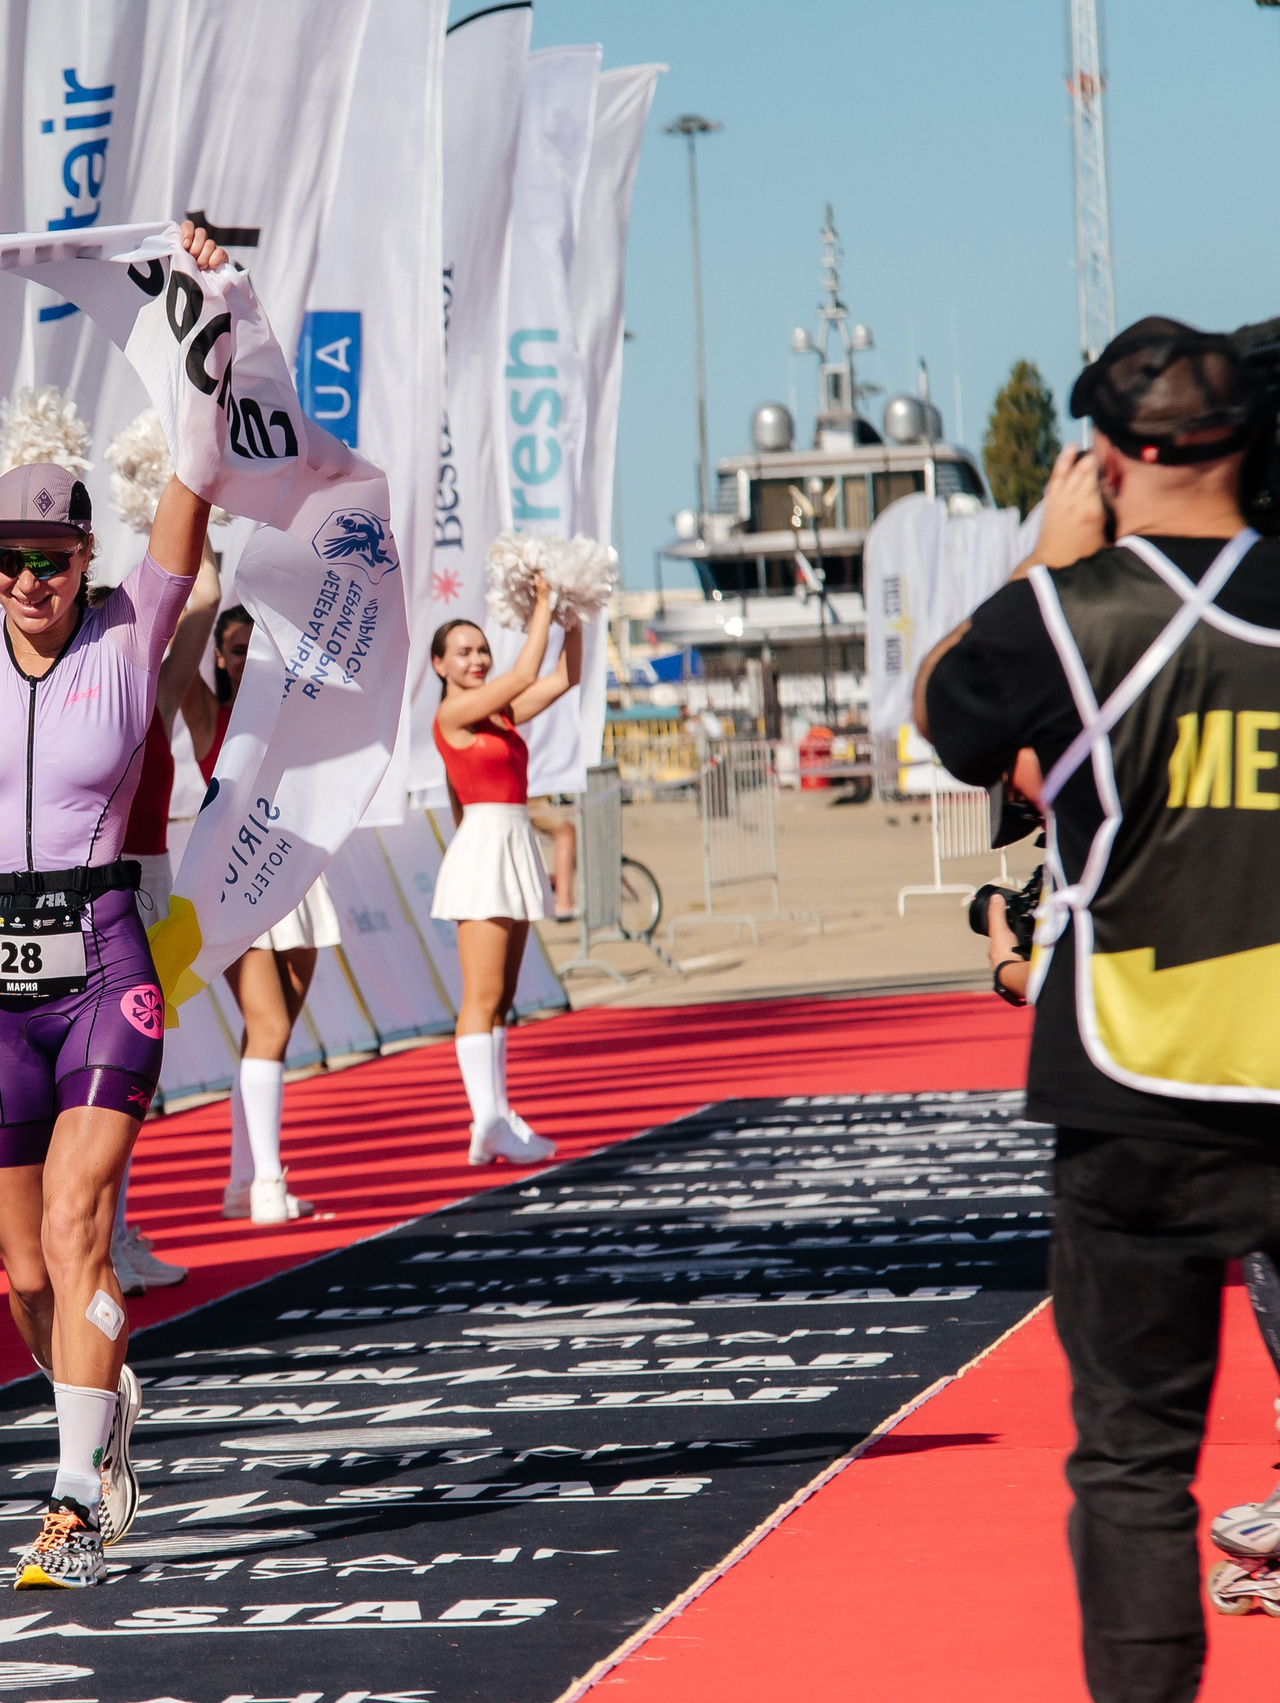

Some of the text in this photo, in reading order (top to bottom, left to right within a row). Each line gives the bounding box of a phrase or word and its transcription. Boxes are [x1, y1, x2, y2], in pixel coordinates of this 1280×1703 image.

[505, 328, 562, 532] resh
[1, 942, 43, 974] 28
[6, 982, 38, 992] МАРИЯ
[567, 1352, 894, 1373] STAR
[13, 1386, 838, 1425] ION STAR
[324, 1477, 713, 1503] STAR
[114, 1598, 558, 1628] STAR
